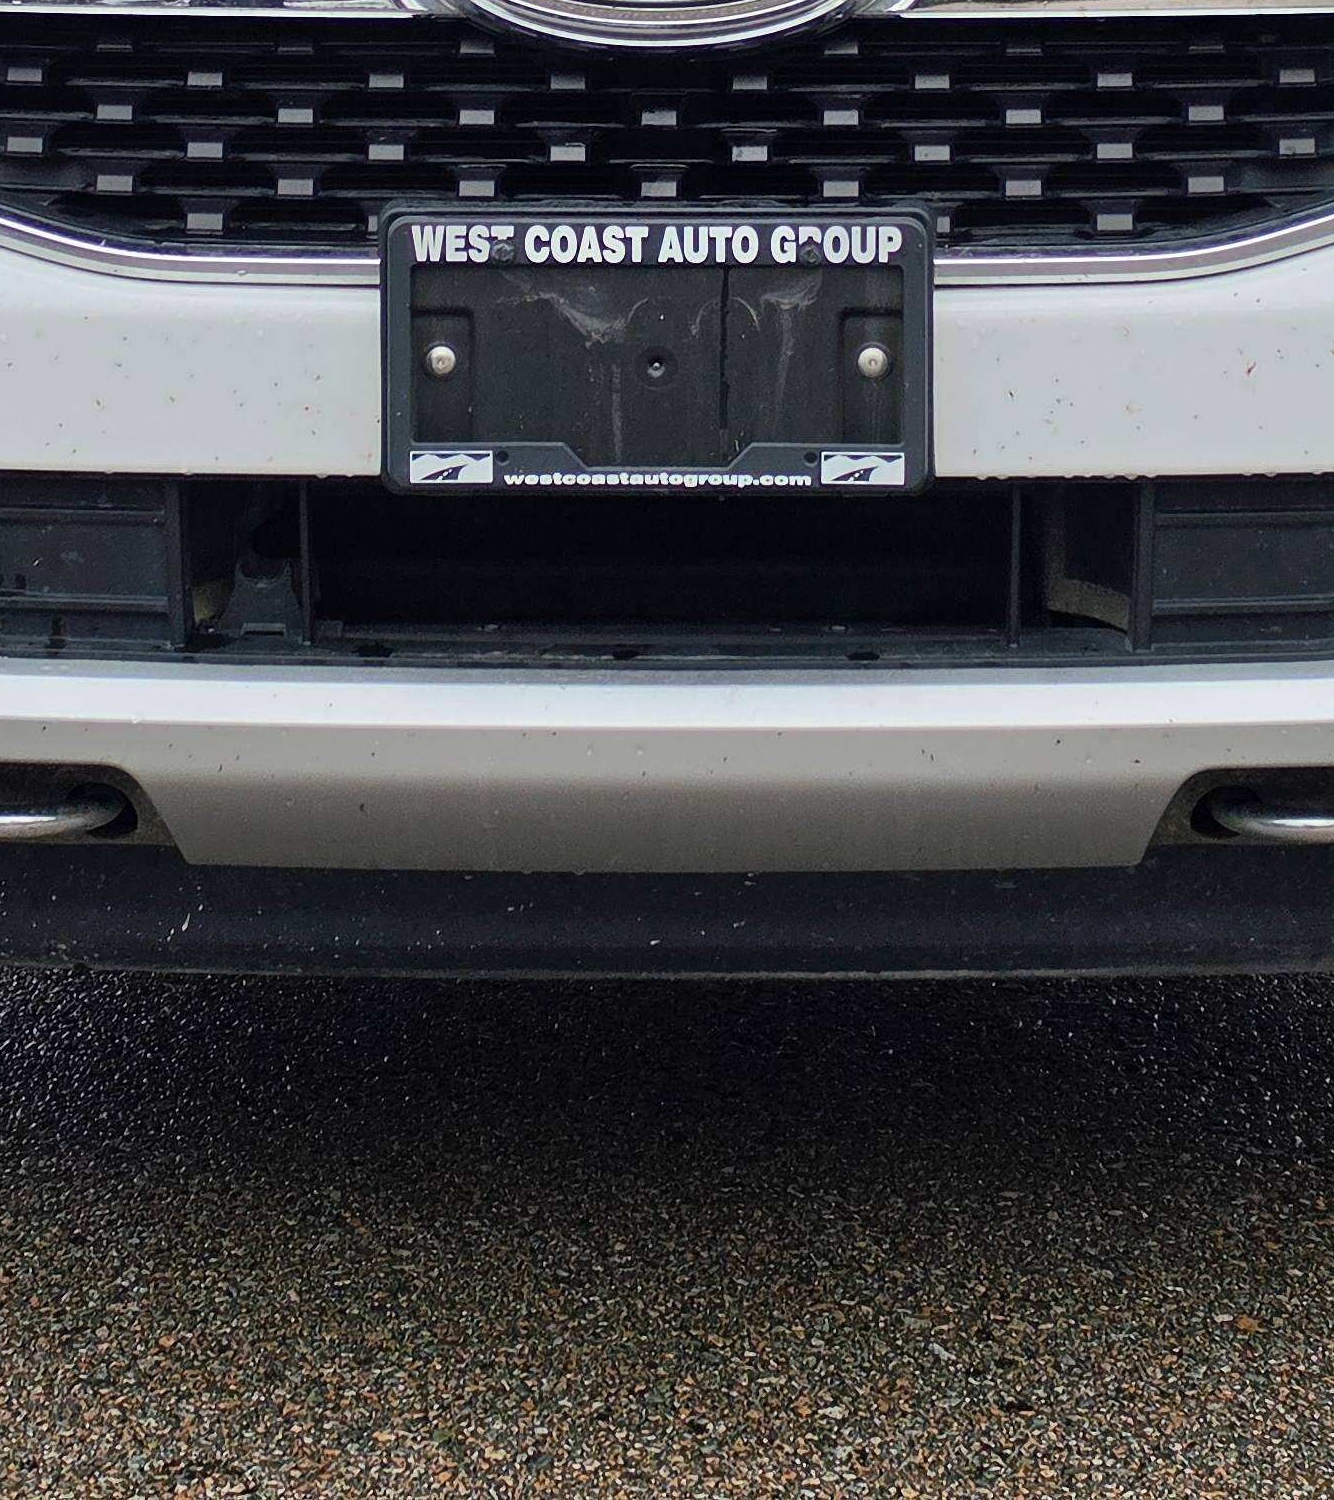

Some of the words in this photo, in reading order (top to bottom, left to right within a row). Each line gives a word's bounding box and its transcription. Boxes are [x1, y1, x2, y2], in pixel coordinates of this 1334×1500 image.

[524, 225, 649, 263] COAST
[657, 225, 760, 264] AUTO
[504, 473, 812, 488] westcoastautogroup.com
